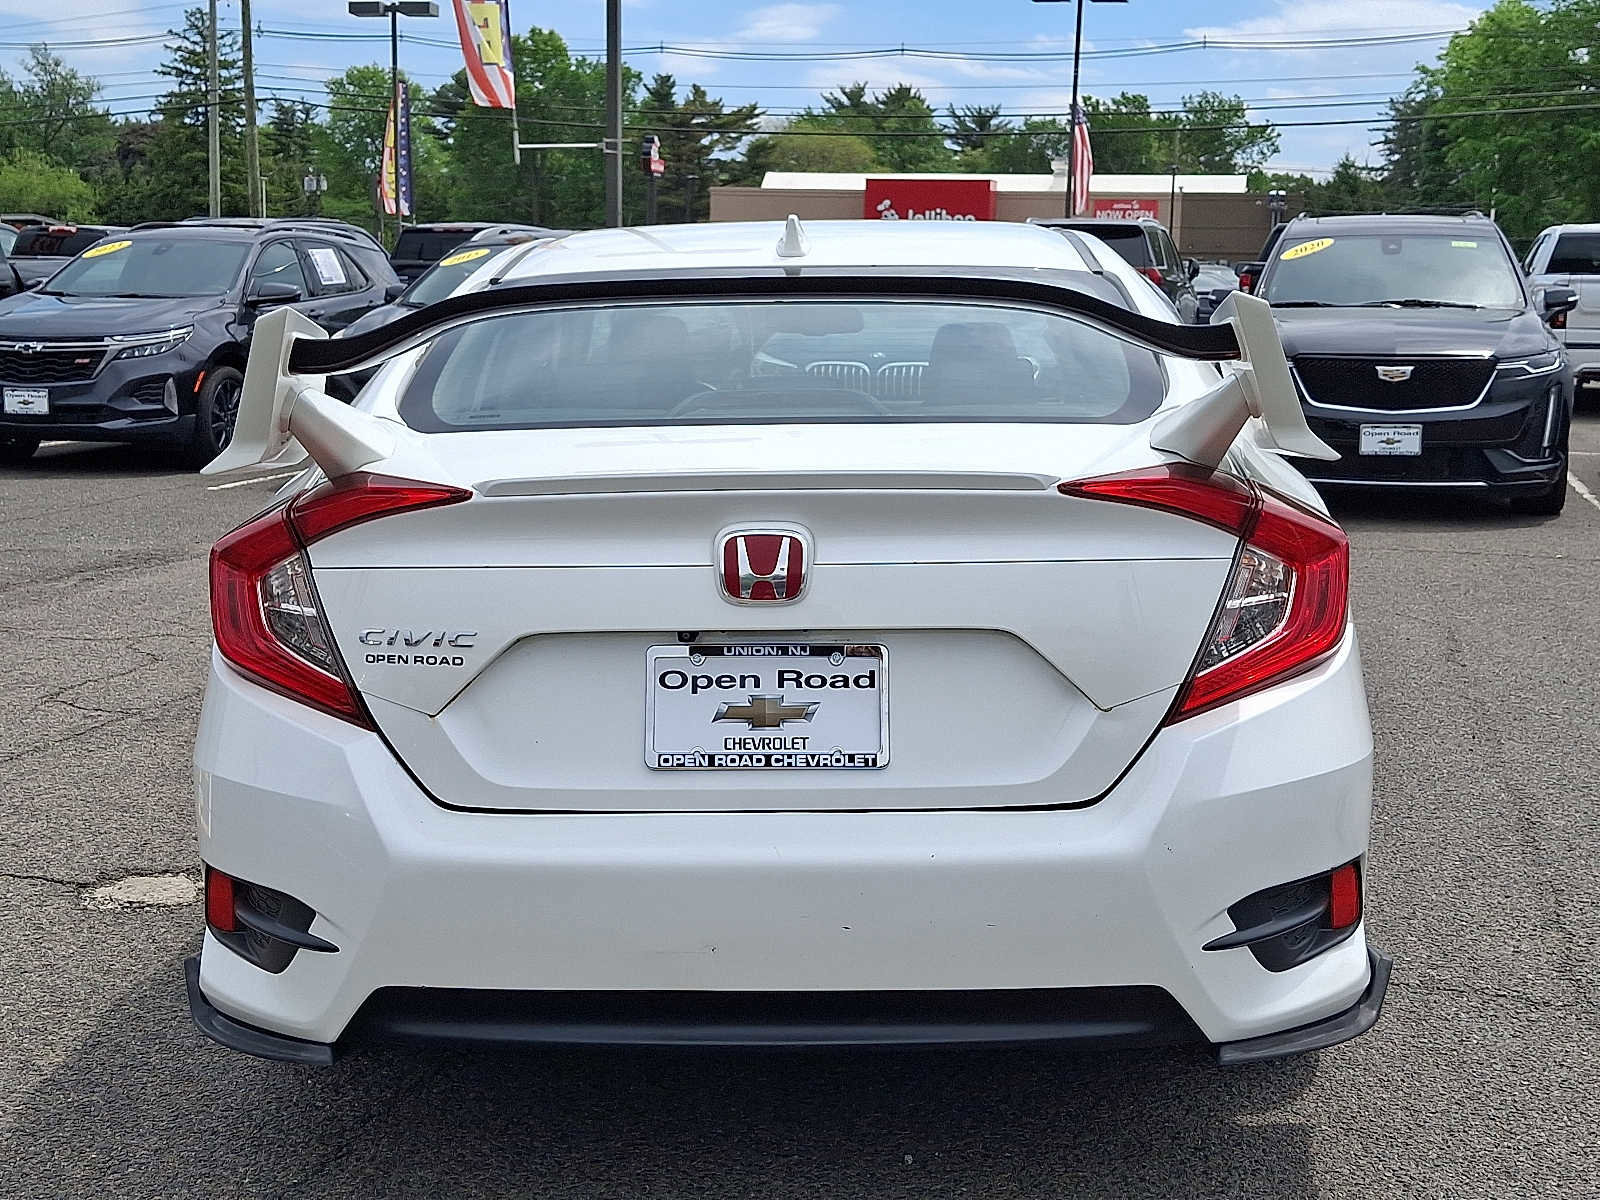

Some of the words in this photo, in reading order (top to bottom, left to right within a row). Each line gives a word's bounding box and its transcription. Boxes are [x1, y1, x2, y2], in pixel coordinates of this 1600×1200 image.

[1096, 210, 1123, 220] NOW
[1125, 210, 1154, 220] OPEN
[1294, 241, 1324, 255] 2020
[358, 628, 478, 648] CIVIC
[723, 646, 782, 656] UNION,
[788, 646, 810, 656] NJ
[365, 654, 409, 665] OPEN
[413, 655, 464, 666] ROAD
[659, 670, 761, 695] Open
[777, 669, 876, 690] Road
[723, 736, 810, 751] CHEVROLET
[659, 754, 709, 767] OPEN
[714, 754, 766, 767] ROAD
[770, 754, 876, 767] CHEVROLET
